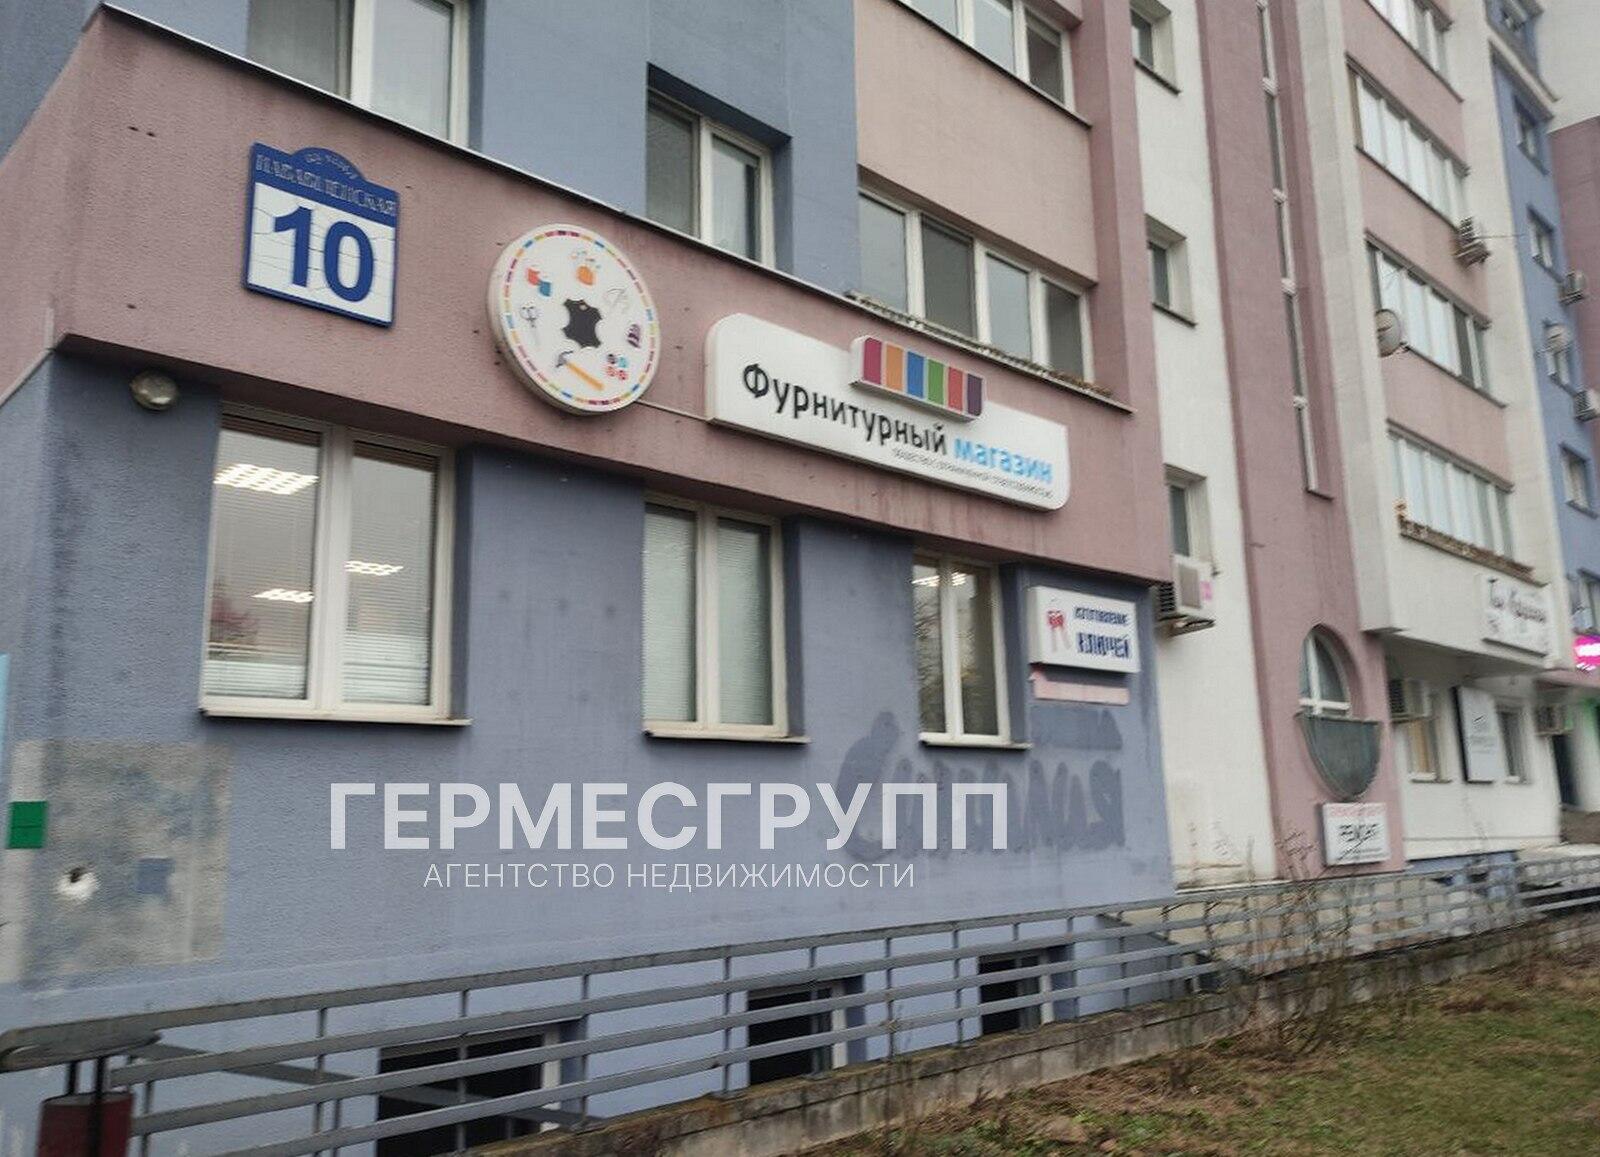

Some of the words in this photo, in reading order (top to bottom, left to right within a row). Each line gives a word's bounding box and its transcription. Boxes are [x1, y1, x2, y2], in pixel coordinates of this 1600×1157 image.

[274, 206, 374, 302] 10
[743, 363, 948, 455] Фурнитурный
[953, 438, 1053, 484] магазин
